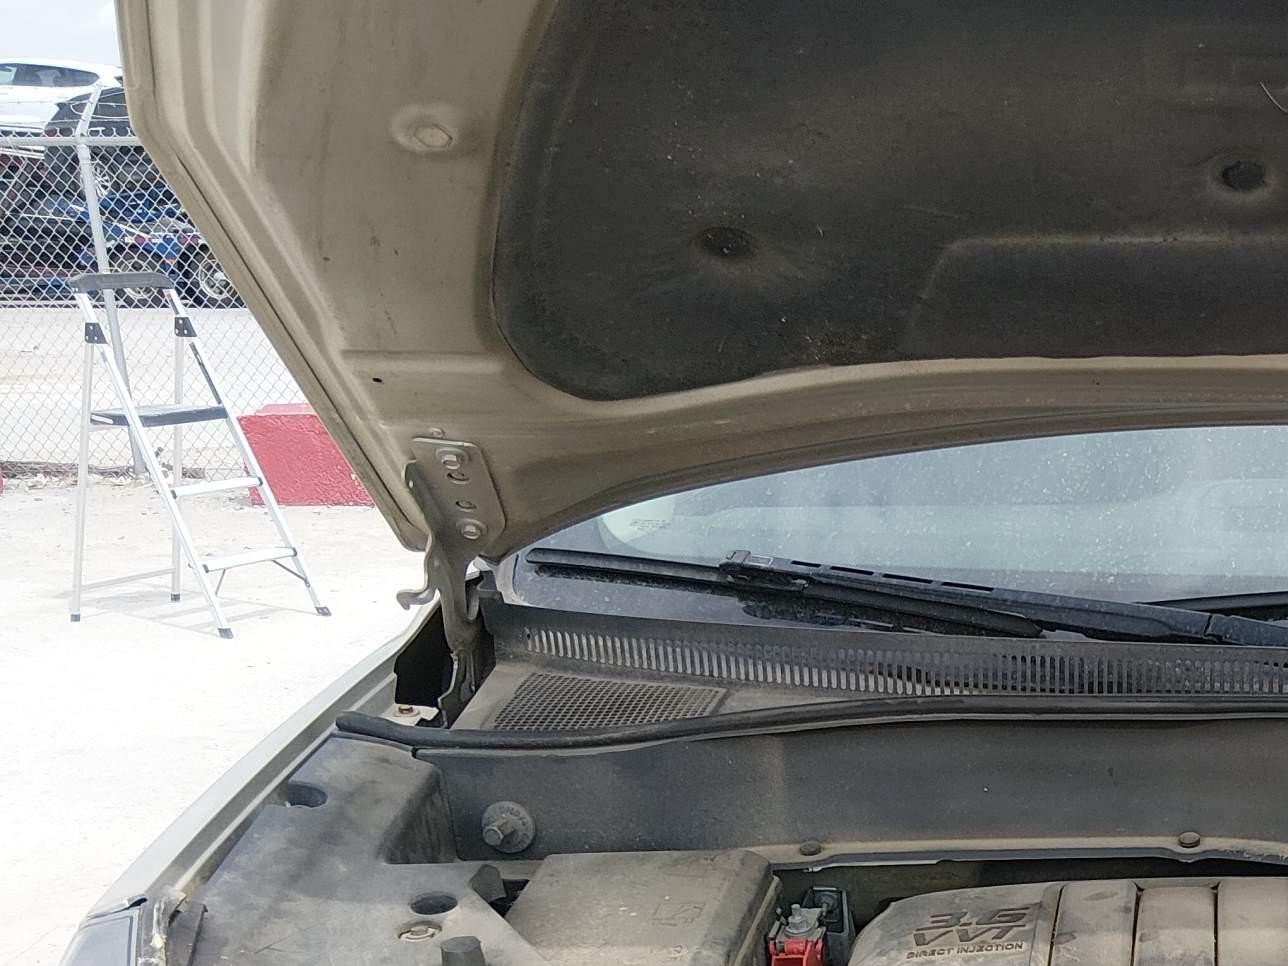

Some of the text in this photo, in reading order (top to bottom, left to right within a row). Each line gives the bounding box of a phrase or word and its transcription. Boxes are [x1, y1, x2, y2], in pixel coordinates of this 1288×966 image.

[915, 906, 1030, 931] 3.6
[913, 924, 1026, 947] VVT
[906, 942, 1024, 959] DIRECT INJECTION
